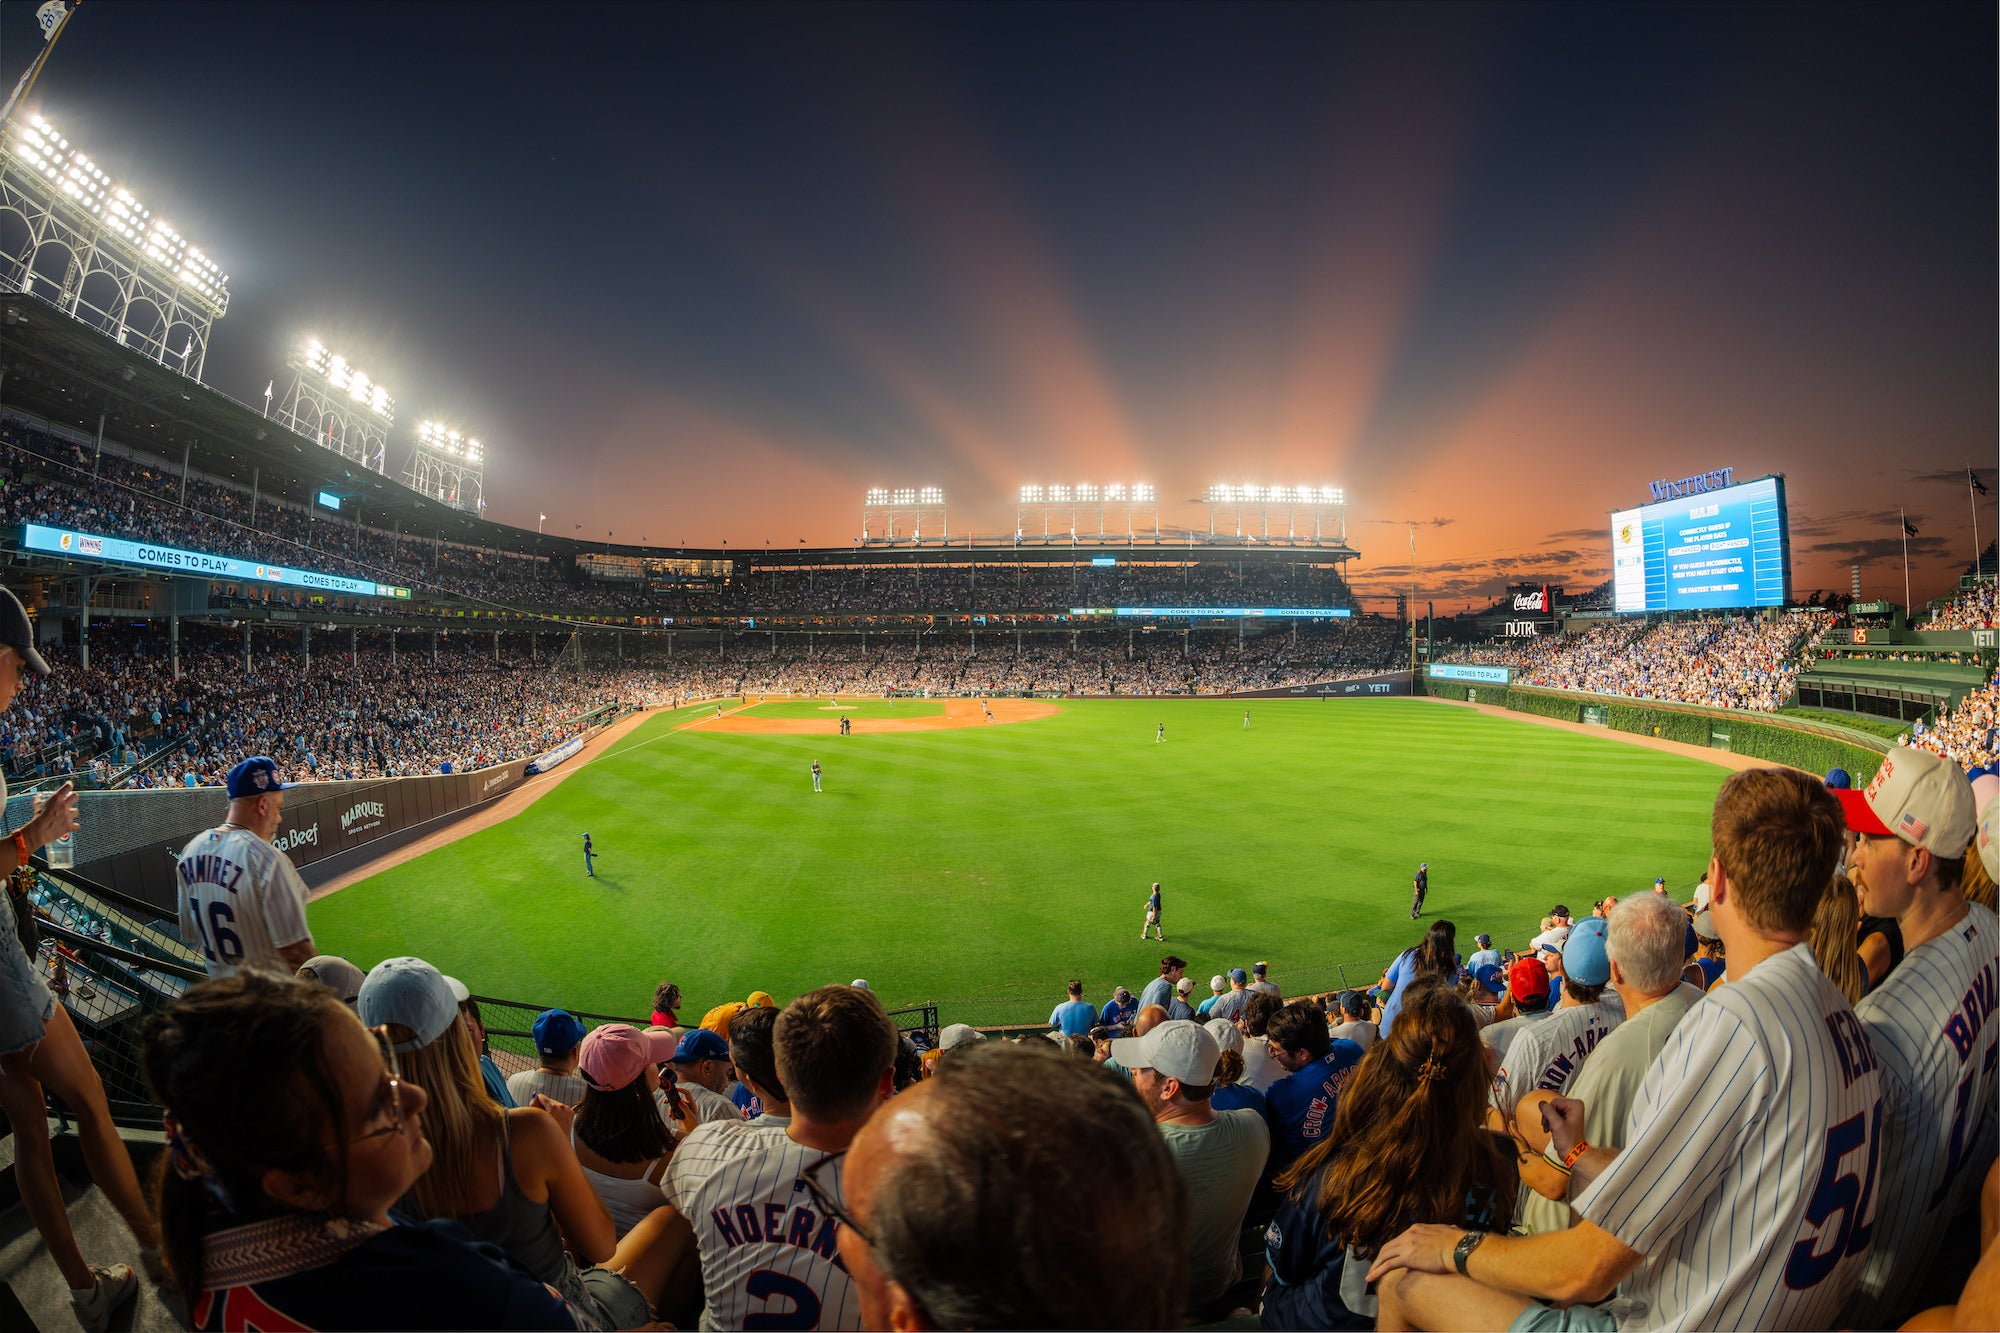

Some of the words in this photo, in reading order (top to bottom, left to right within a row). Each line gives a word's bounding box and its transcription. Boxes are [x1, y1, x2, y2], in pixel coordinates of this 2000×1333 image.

[138, 548, 181, 565] COMES
[184, 555, 199, 567] TO
[202, 558, 229, 572] PLAY
[303, 574, 330, 586] COMES
[331, 579, 340, 588] TO
[341, 581, 358, 590] PLAY
[1861, 603, 1879, 613] Mobile
[1971, 630, 1995, 647] YETI
[1456, 669, 1476, 678] COMES
[1476, 670, 1486, 678] TO
[1486, 671, 1501, 680] PLAY
[1367, 683, 1390, 693] YETI
[340, 801, 385, 831] MARQUEE
[179, 855, 244, 895] RAMIREZ
[189, 898, 244, 966] 16
